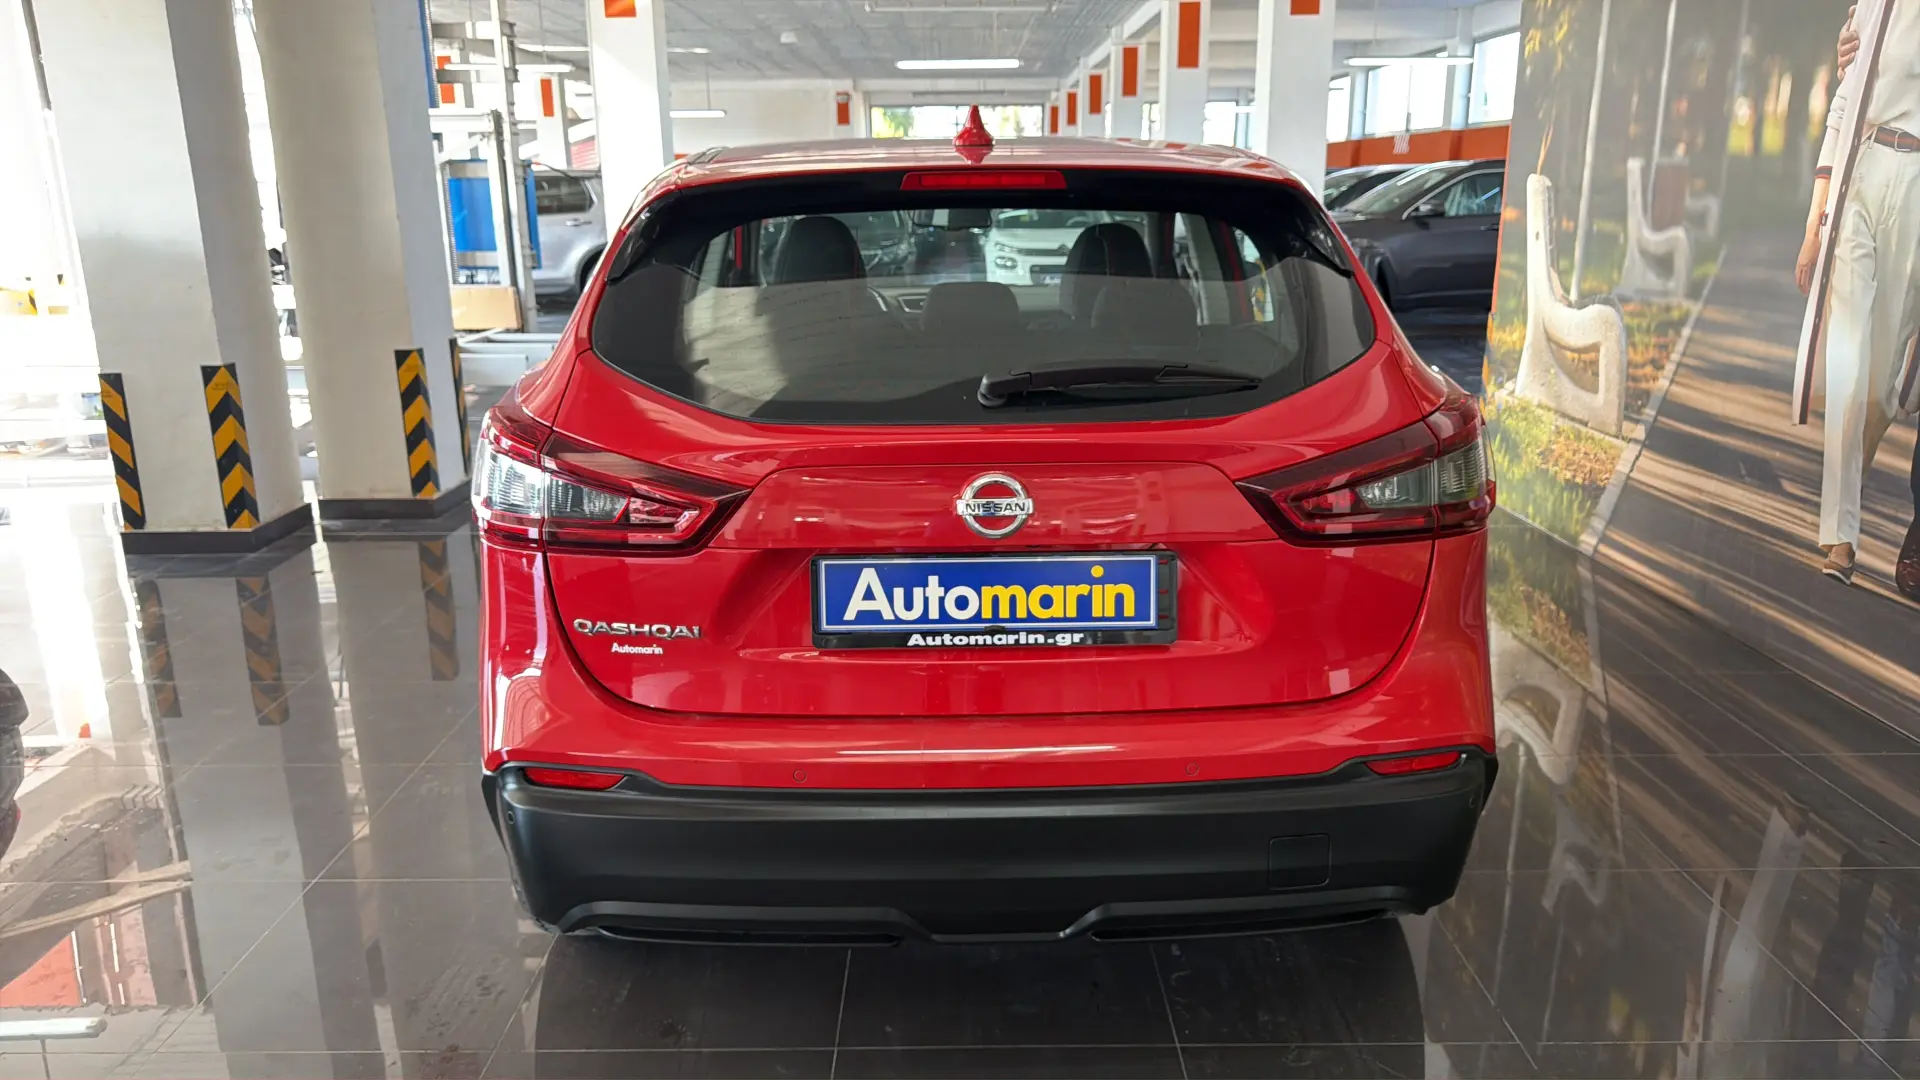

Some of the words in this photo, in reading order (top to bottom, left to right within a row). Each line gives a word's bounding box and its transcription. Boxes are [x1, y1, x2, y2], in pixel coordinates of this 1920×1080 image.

[965, 502, 1026, 513] NISSAN
[843, 565, 1136, 621] Automarin
[573, 618, 702, 640] QASHQAI
[907, 631, 1085, 647] Automarin.gr
[611, 642, 663, 655] Automarin
